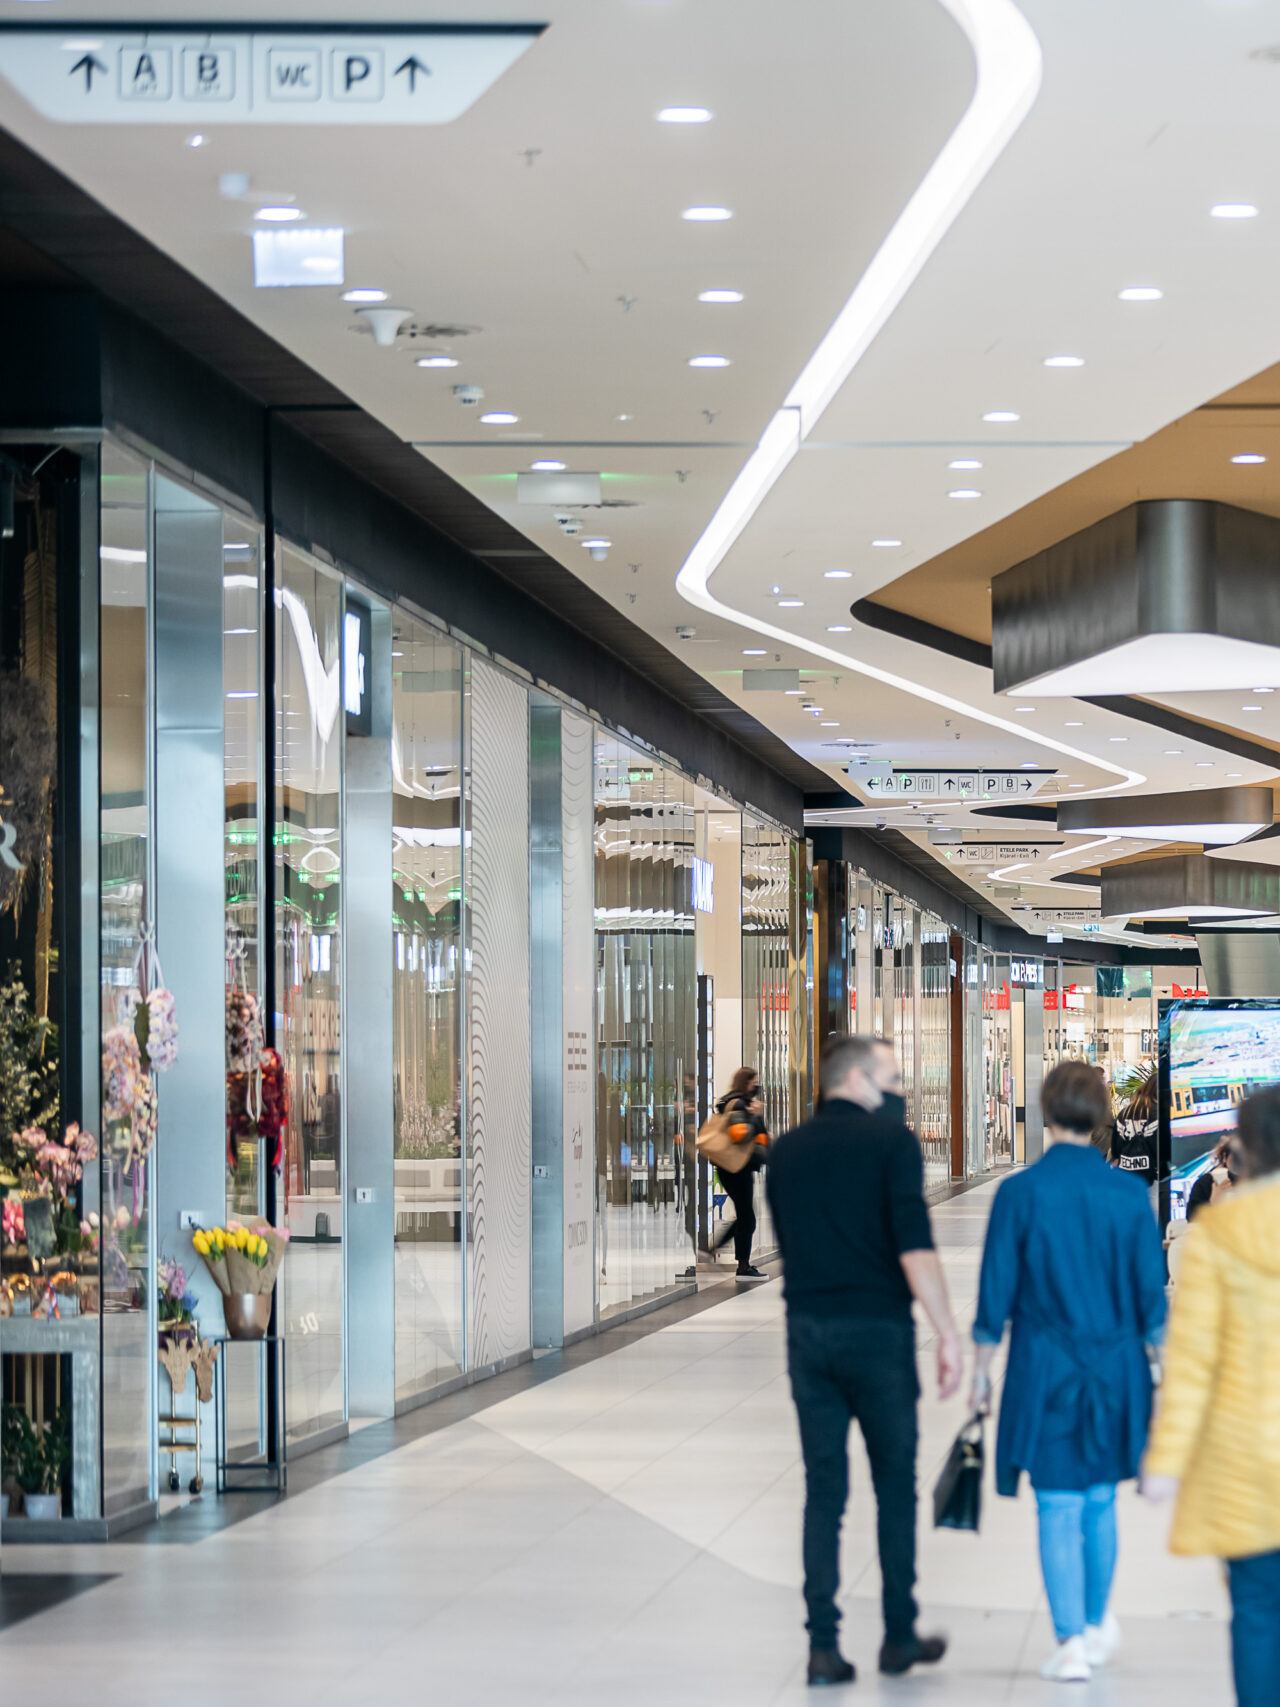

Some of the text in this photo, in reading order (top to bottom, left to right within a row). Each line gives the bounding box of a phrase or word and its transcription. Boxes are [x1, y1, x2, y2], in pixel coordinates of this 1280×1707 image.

[133, 53, 371, 92] A B WC P
[885, 778, 1014, 790] A P WC P B
